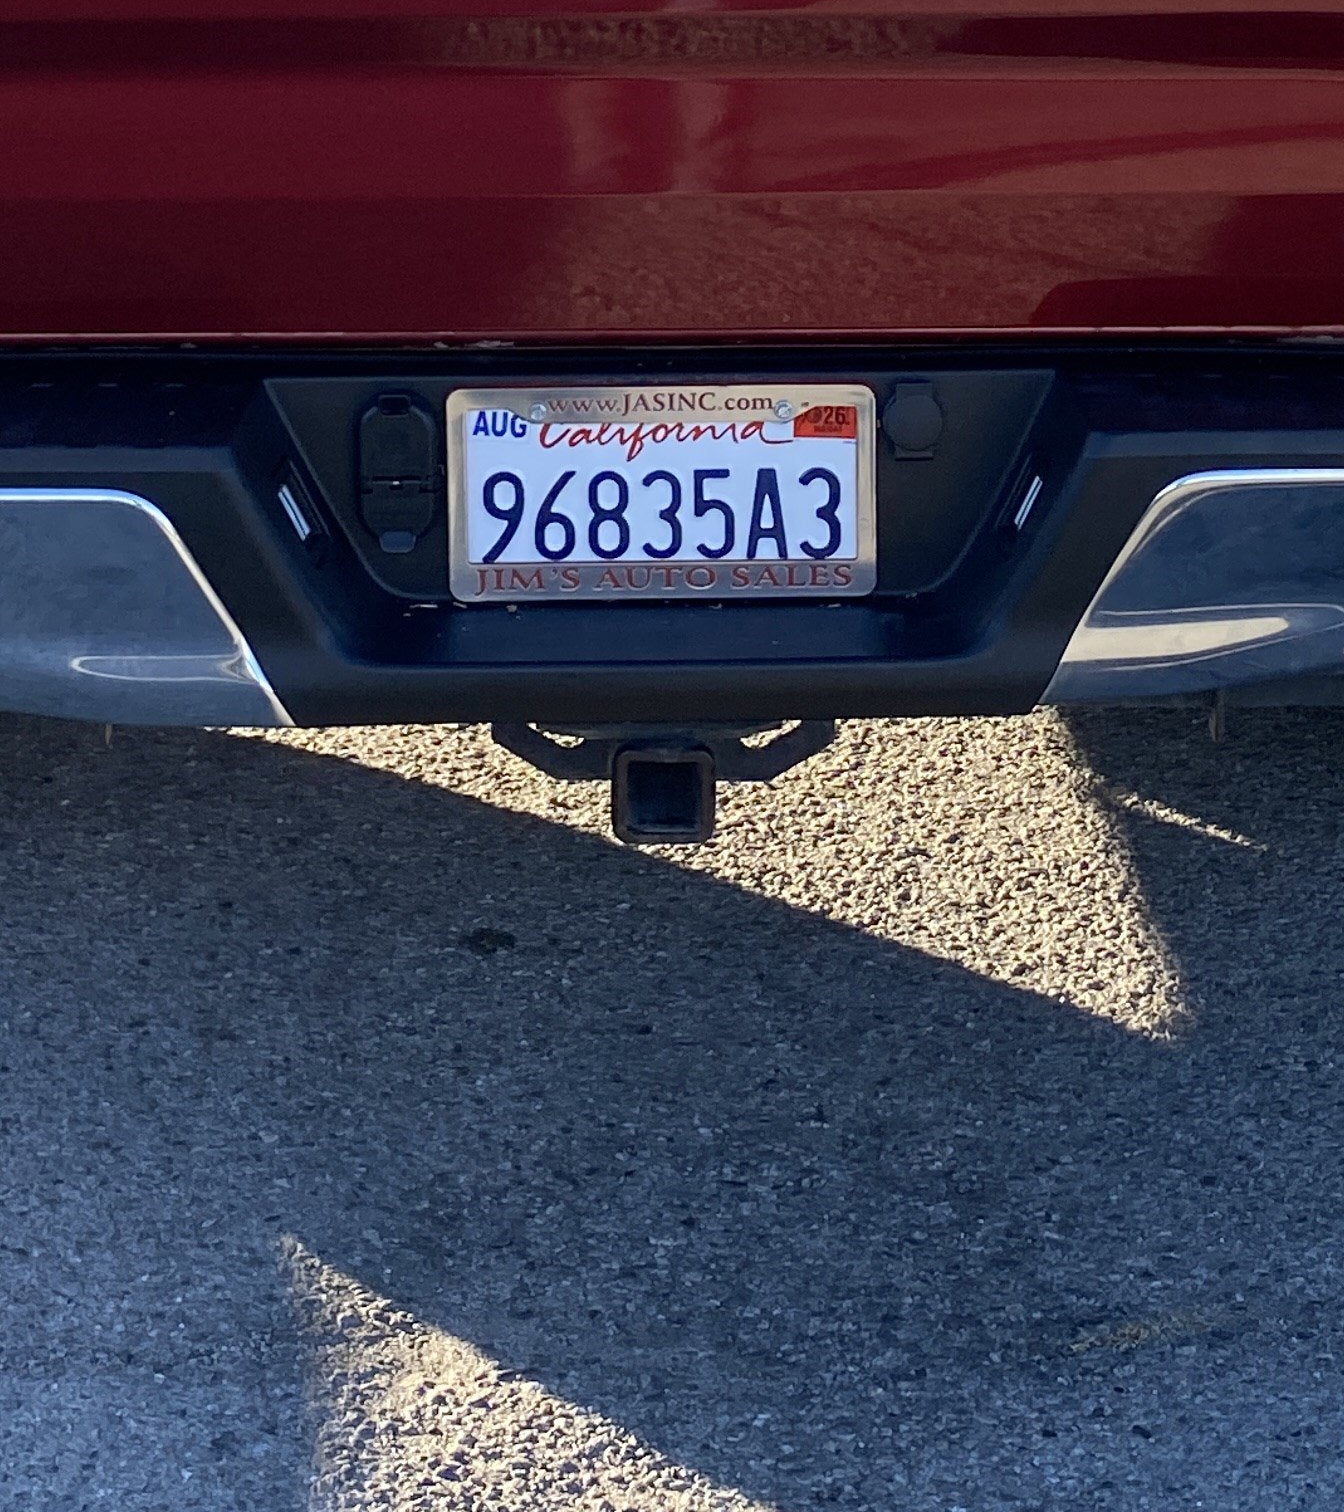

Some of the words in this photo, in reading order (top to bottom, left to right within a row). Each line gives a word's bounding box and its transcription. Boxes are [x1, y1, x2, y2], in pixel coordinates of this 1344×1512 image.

[547, 392, 773, 417] www.JASINC.com
[472, 411, 527, 438] AUG
[539, 421, 794, 462] California
[482, 467, 842, 563] 96835A3
[475, 568, 580, 596] JIM'S
[597, 567, 716, 590] AUTO
[731, 564, 853, 588] SALES
